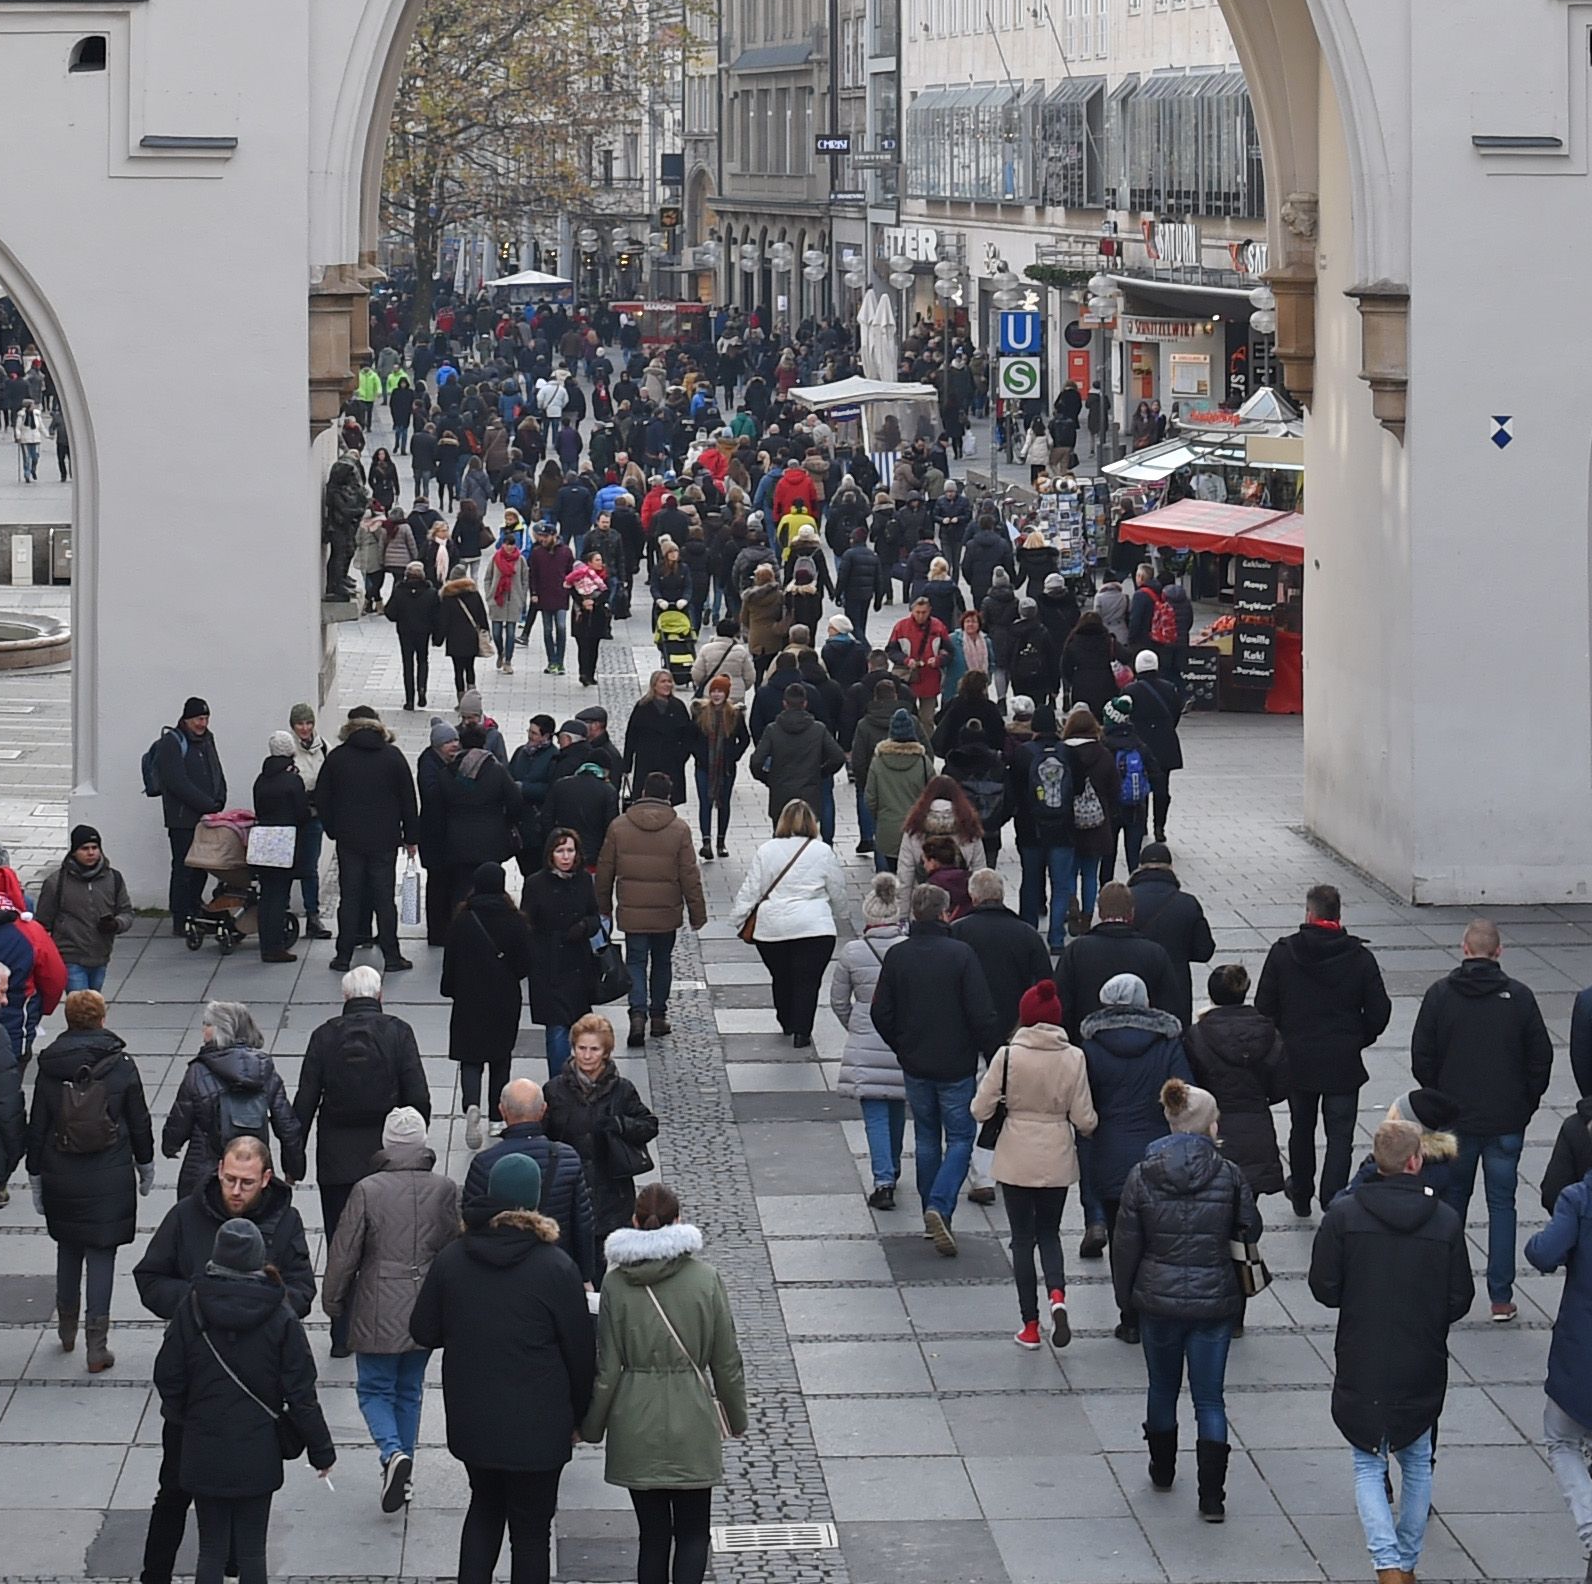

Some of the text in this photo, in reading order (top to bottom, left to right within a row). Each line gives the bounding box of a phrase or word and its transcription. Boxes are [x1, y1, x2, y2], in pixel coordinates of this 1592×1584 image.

[884, 227, 938, 262] ETTER
[1157, 223, 1197, 265] SATURN
[1247, 242, 1268, 274] SAT
[1008, 315, 1032, 350] U
[1009, 364, 1031, 392] S
